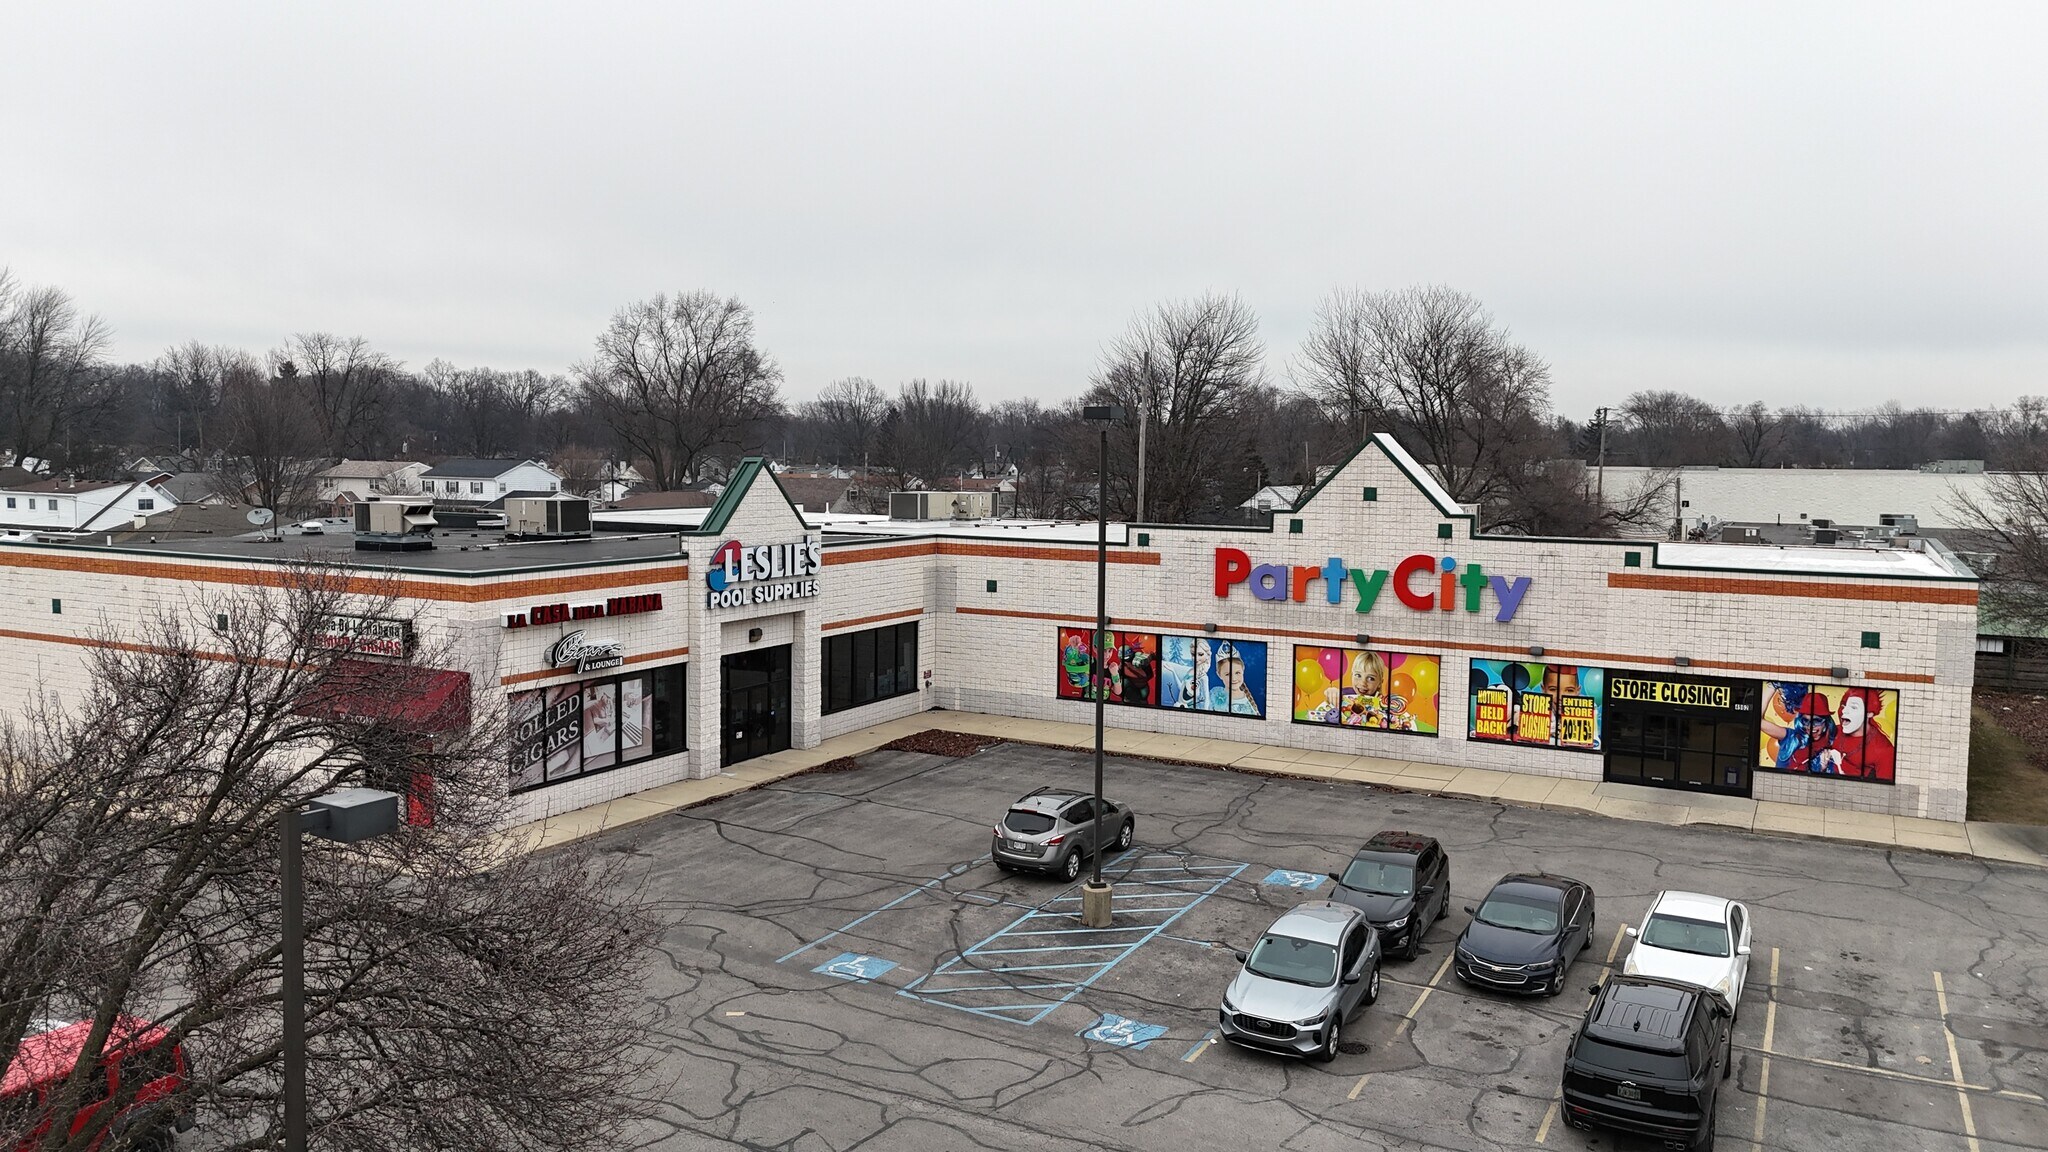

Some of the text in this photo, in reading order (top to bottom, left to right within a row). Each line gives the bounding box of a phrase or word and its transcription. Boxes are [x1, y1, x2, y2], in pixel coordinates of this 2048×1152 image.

[724, 535, 821, 583] LESLIE'S
[709, 580, 820, 609] POOL SUPPLIES
[507, 614, 527, 628] LA
[530, 603, 570, 625] CASA
[607, 593, 662, 616] HABANA
[551, 630, 624, 674] Cigars
[584, 658, 621, 671] & LOUNGE
[1477, 689, 1507, 705] NOTHING
[1522, 693, 1551, 714] STORE
[1562, 697, 1593, 708] ENTIRE
[1612, 678, 1728, 707] STORE CLOSING!
[1480, 705, 1505, 720] HELD
[1564, 706, 1593, 718] STORE
[1476, 720, 1508, 735] BACK!
[1519, 711, 1550, 741] CLOSING
[510, 719, 579, 774] CIGARS
